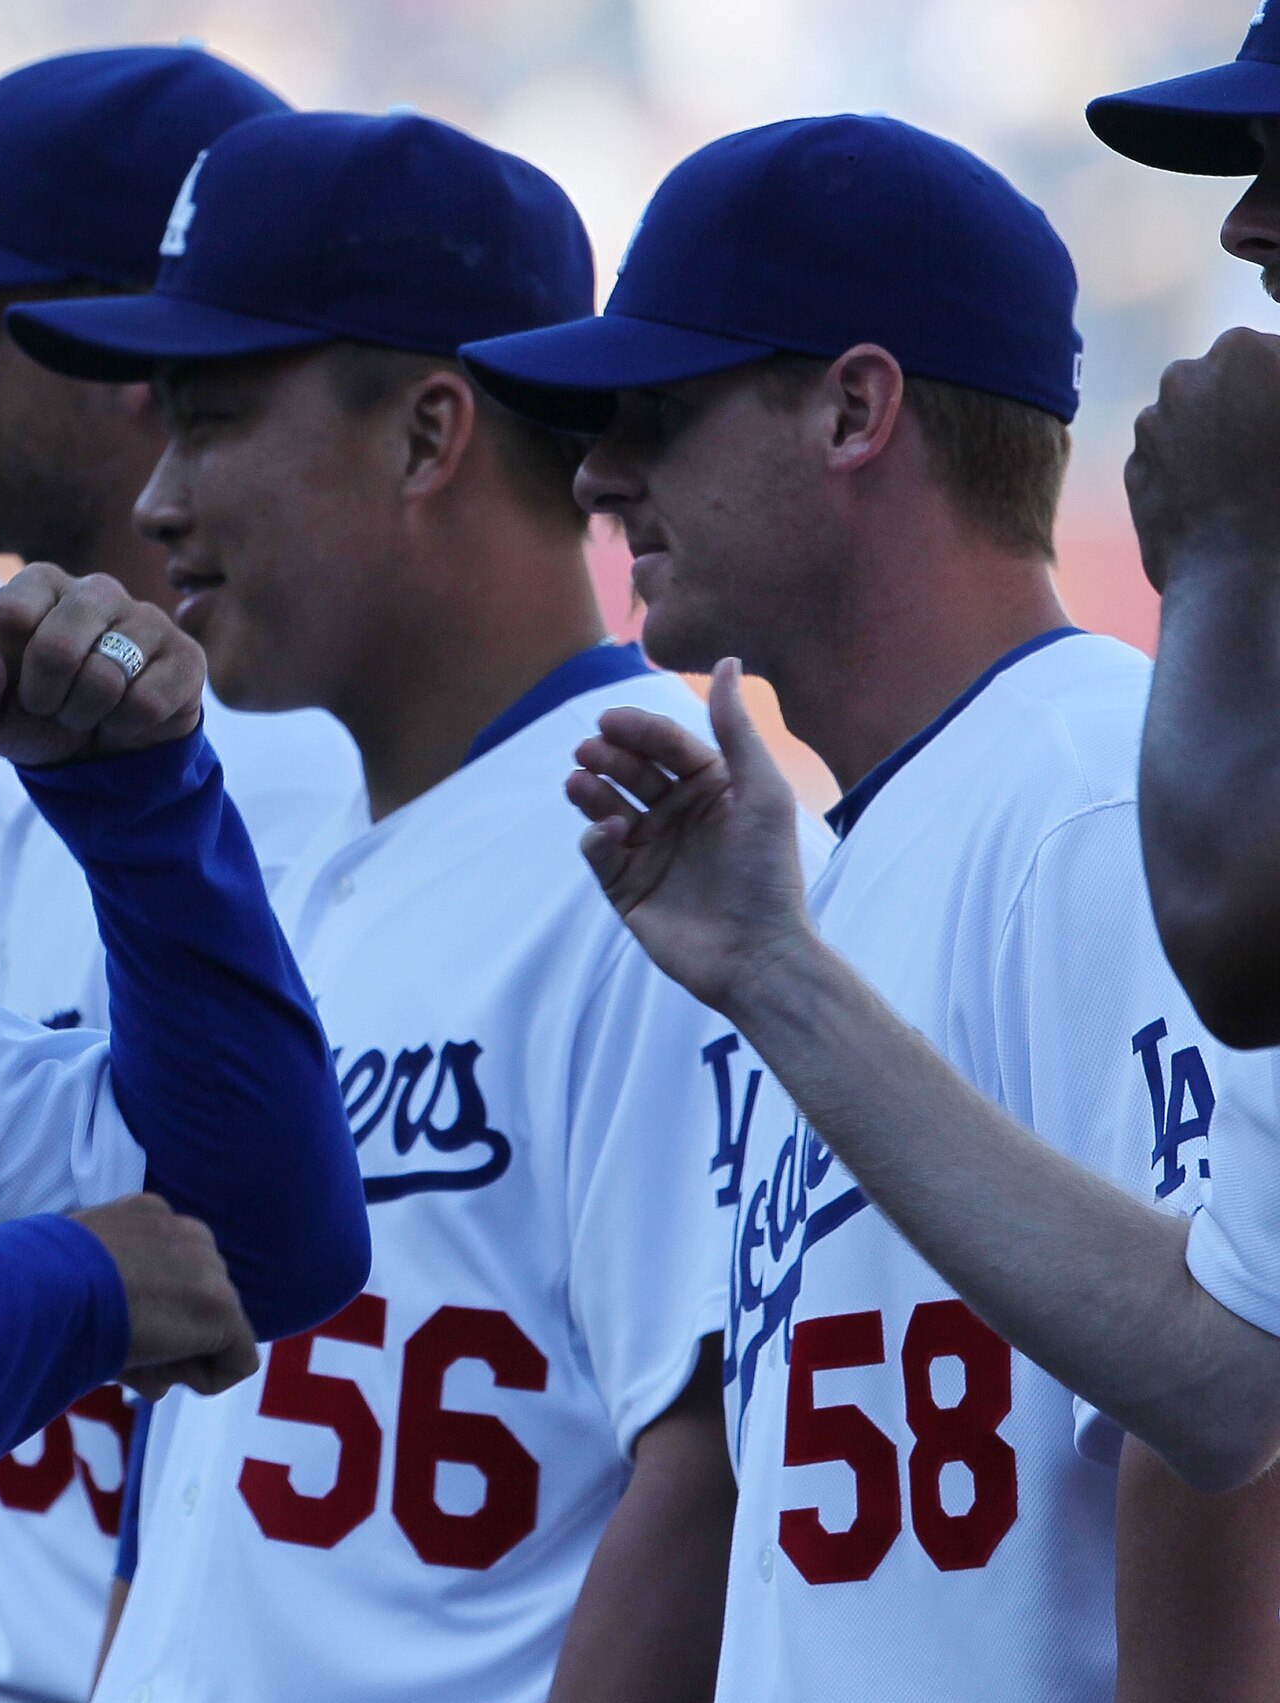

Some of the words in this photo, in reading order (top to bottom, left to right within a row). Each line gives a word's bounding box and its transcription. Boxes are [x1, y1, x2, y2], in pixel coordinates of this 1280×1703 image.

[1131, 1017, 1216, 1201] LA
[238, 1292, 549, 1571] 56
[778, 1298, 1018, 1586] 58
